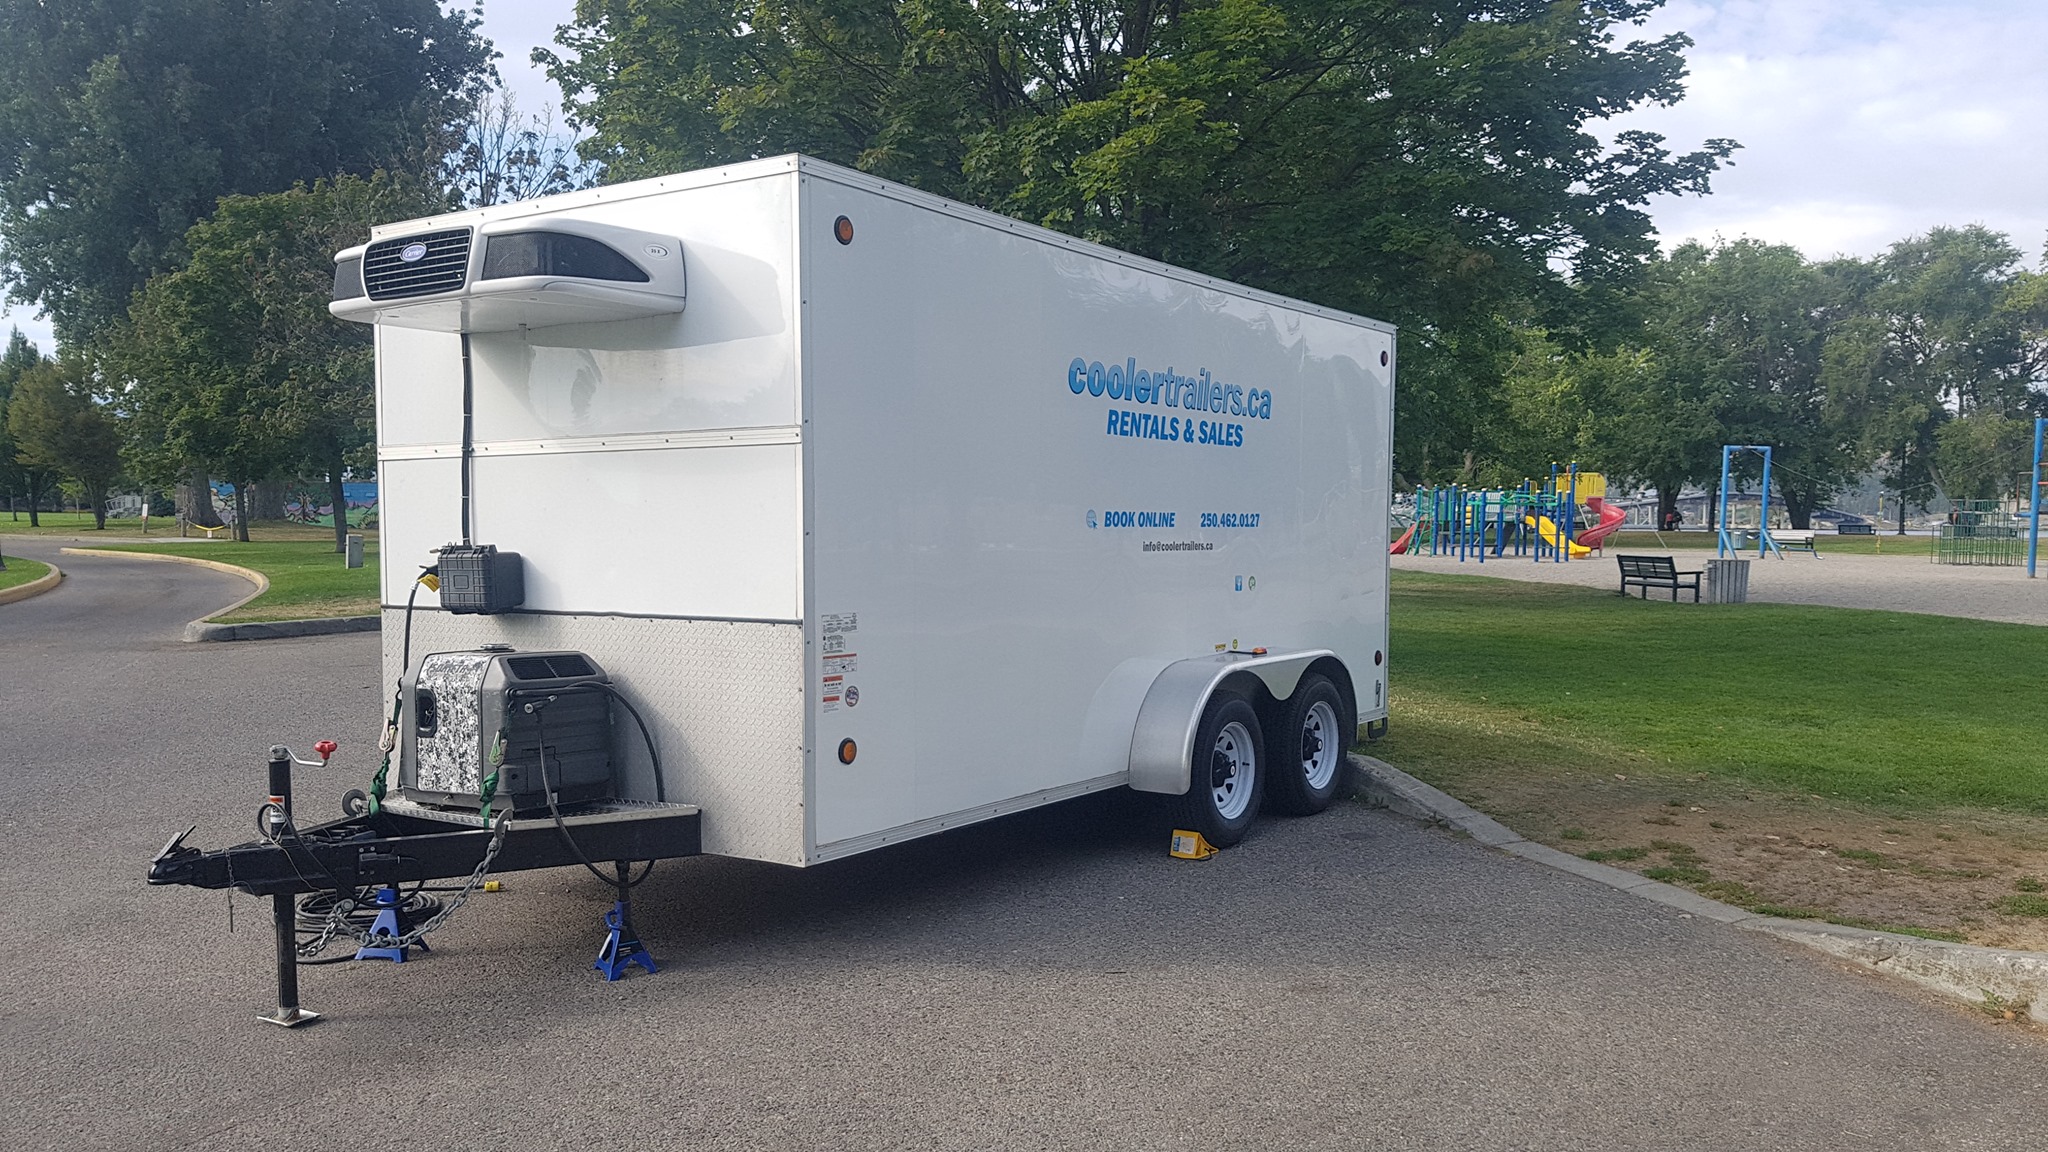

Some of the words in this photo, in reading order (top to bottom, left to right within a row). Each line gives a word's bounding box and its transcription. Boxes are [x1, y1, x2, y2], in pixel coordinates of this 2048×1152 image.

[1068, 357, 1272, 420] coolertrailers.ca
[1106, 409, 1180, 442] RENTALS
[1183, 418, 1195, 443] &
[1198, 420, 1244, 447] SALES
[1104, 511, 1136, 528] BOOK
[1138, 511, 1176, 528] ONLINE
[1200, 512, 1260, 528] 250.462.0127
[1142, 541, 1213, 552] info@coolertrailers.ca
